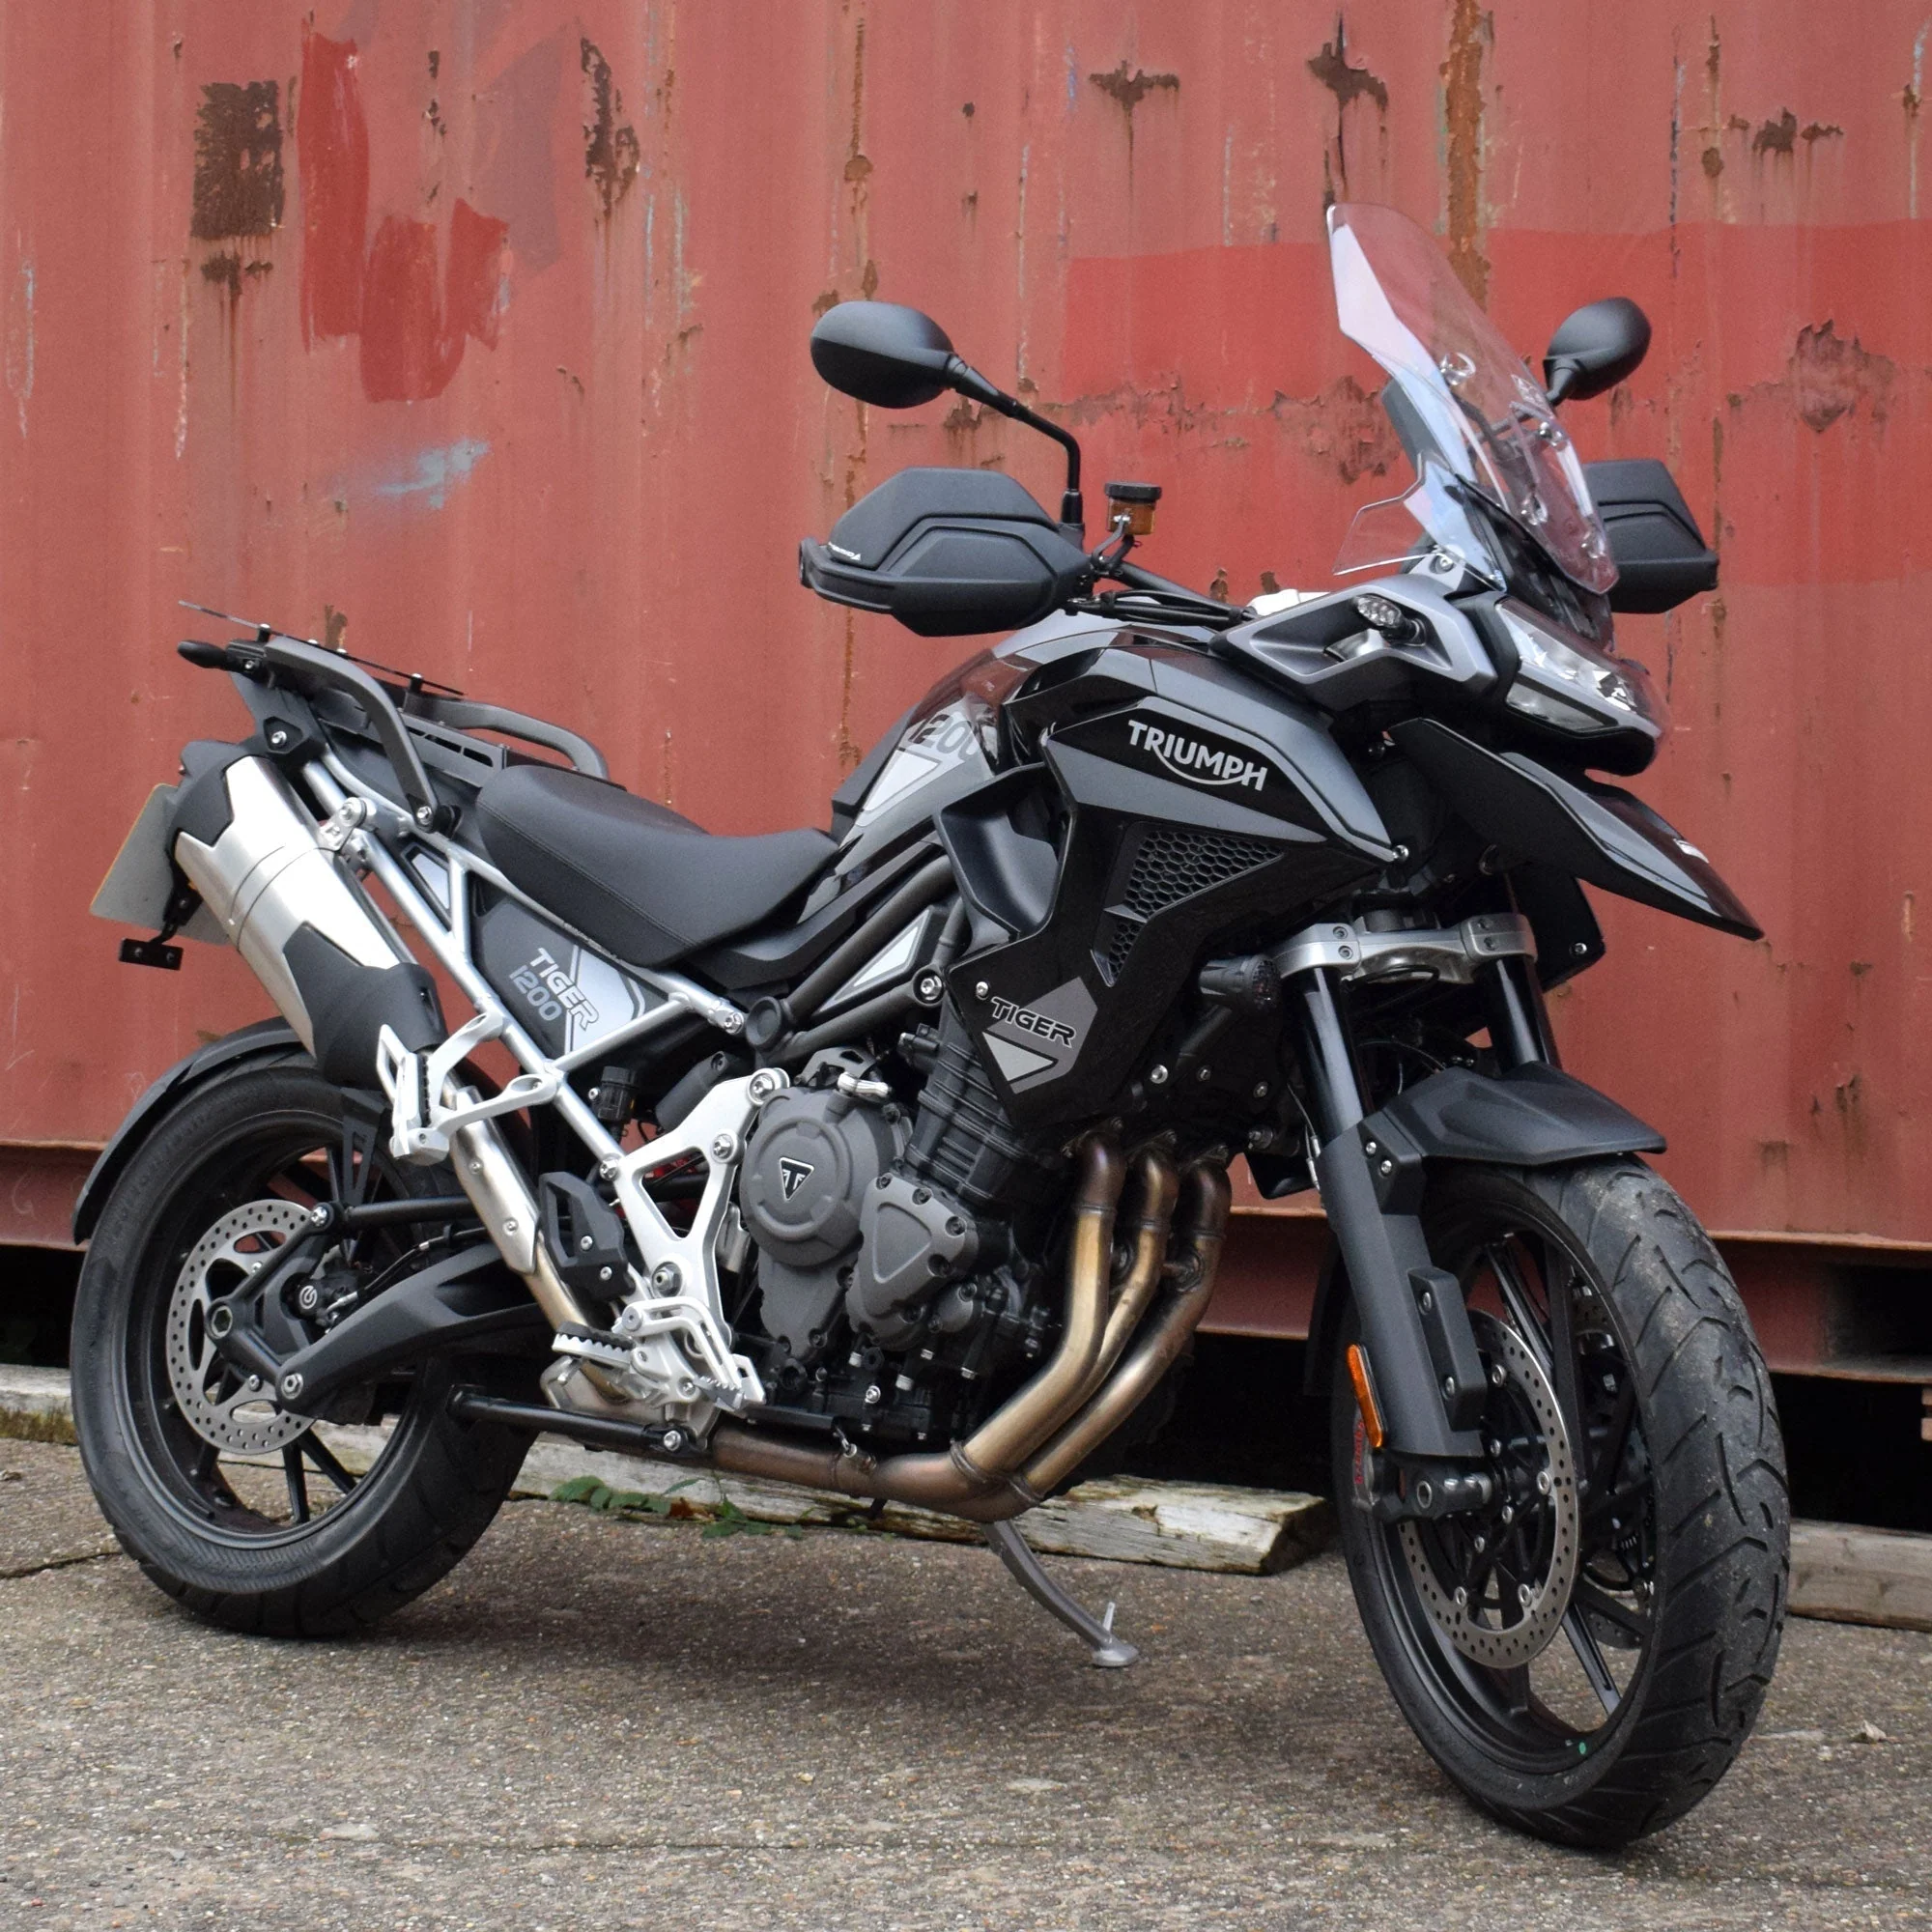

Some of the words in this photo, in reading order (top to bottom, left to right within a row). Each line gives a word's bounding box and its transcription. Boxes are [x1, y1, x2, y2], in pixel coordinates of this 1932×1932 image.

[1128, 720, 1267, 791] TRIUMPH
[509, 965, 562, 1021] 1200
[529, 947, 599, 1031] TIGER
[991, 996, 1076, 1048] TIGER
